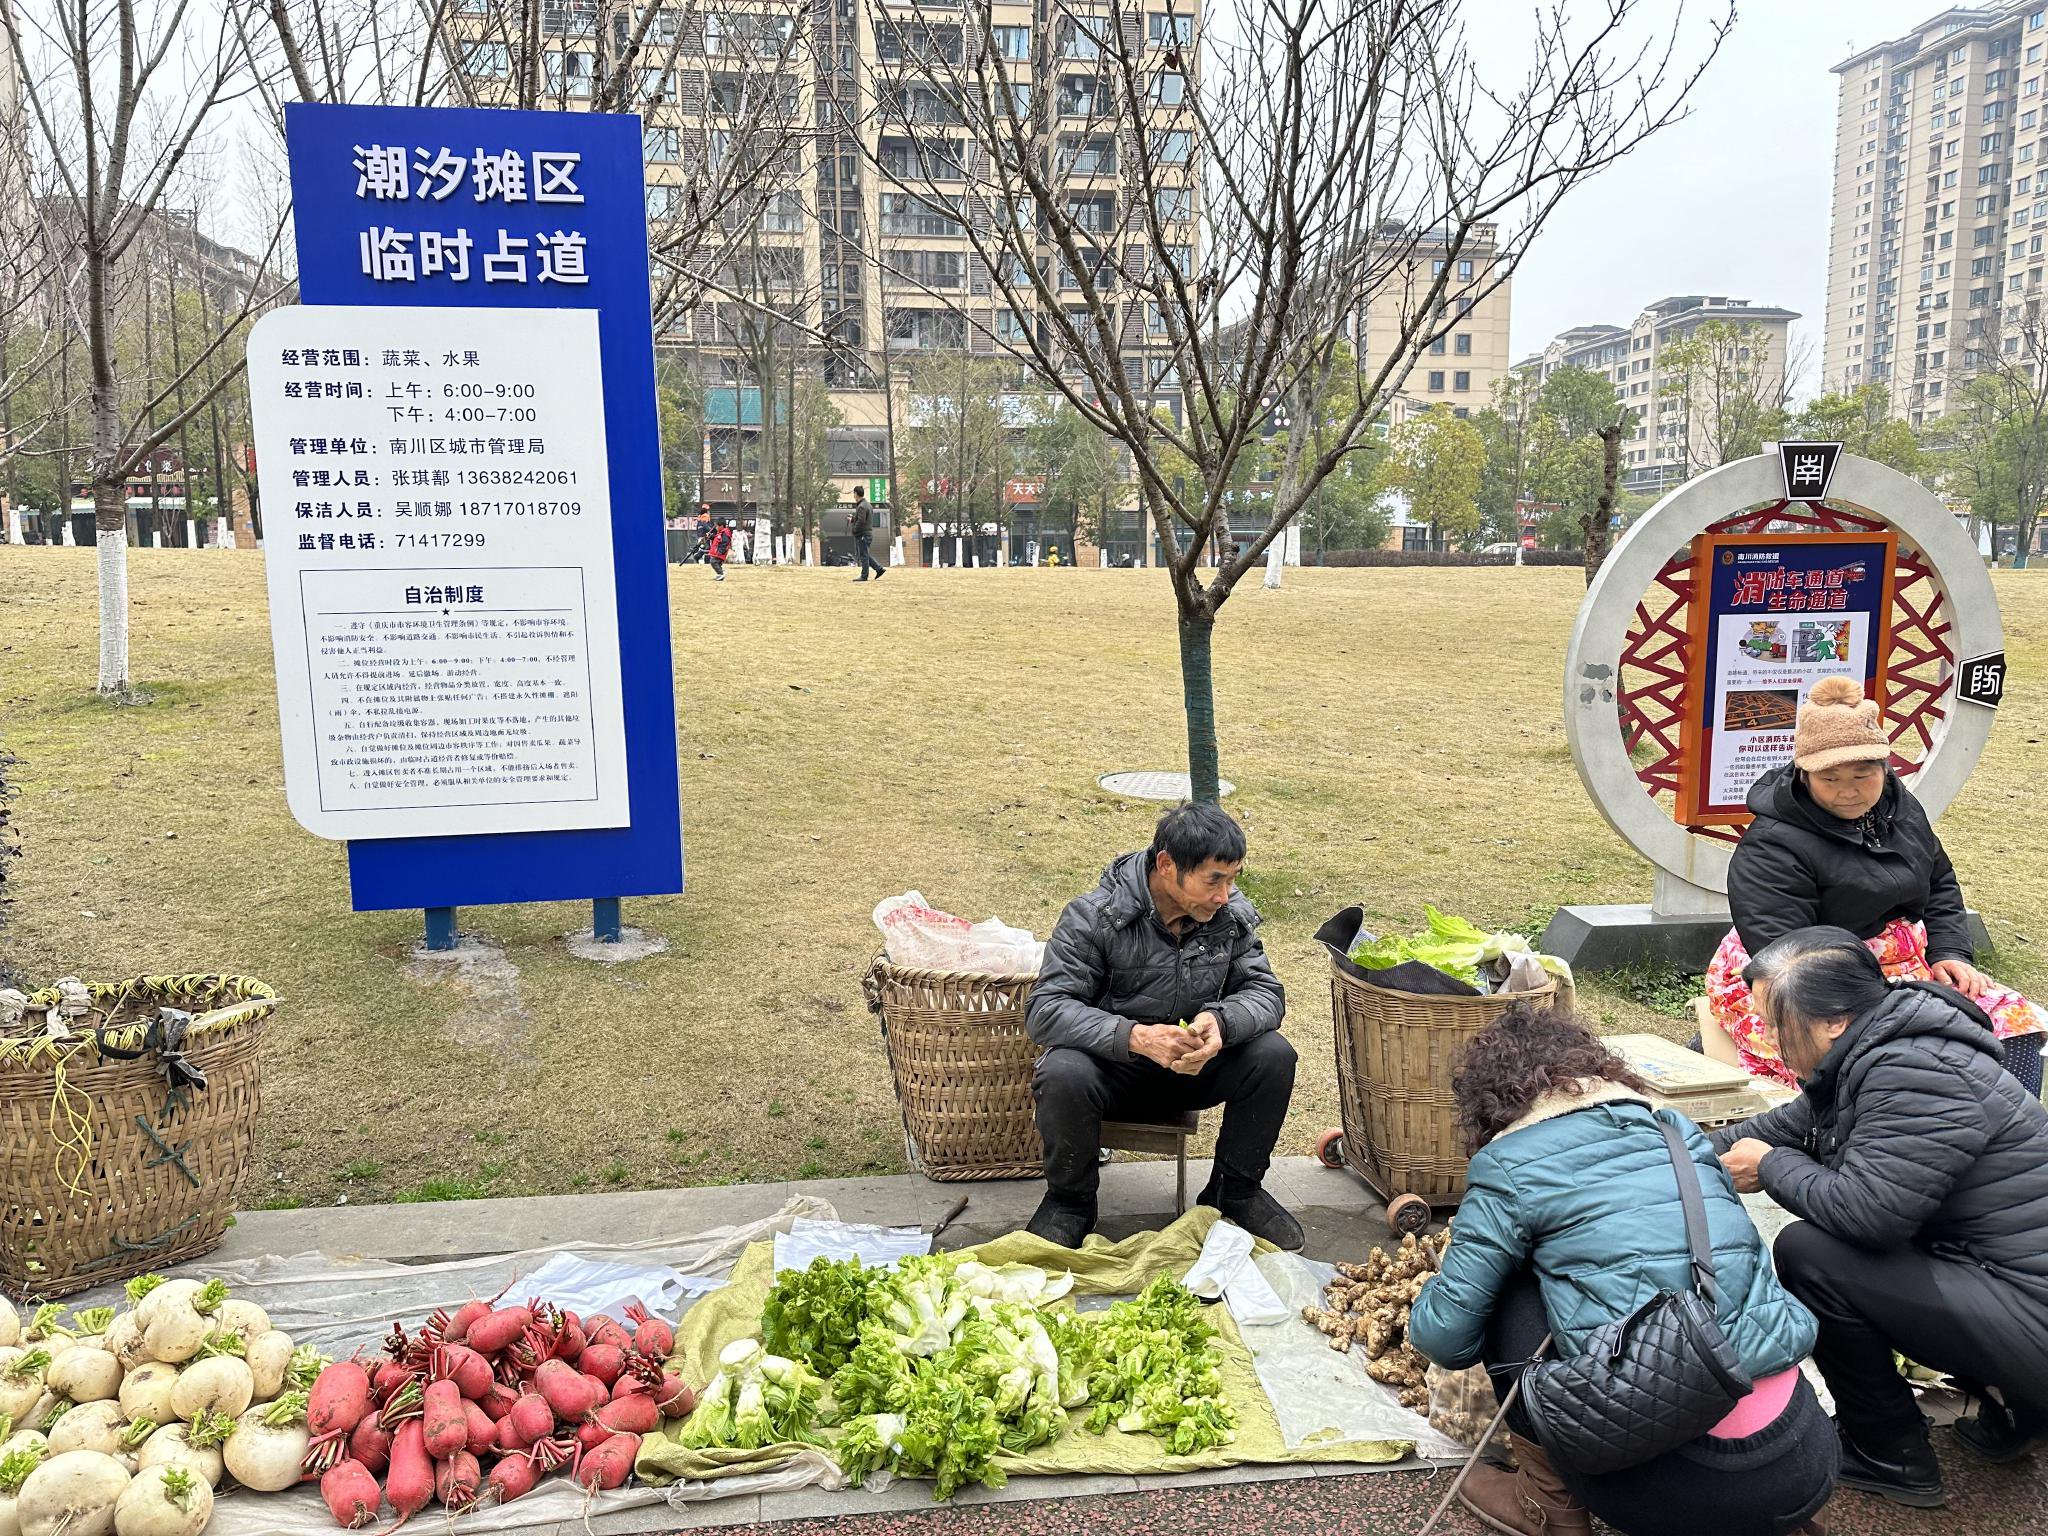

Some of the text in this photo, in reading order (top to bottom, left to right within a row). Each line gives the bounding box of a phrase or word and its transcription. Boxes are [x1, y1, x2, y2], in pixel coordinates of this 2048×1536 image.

[353, 144, 585, 203] 潮汐摊区
[360, 226, 590, 283] 临时占道
[289, 437, 545, 455] 管理单位：南川区城市管理局
[457, 470, 577, 485] 13638242061
[459, 501, 581, 516] 18717018709
[298, 532, 486, 551] 监督电话：71417299
[405, 585, 484, 604] 自治制度
[1731, 566, 1845, 606] 消防车通道
[1768, 590, 1848, 611] 生命通道
